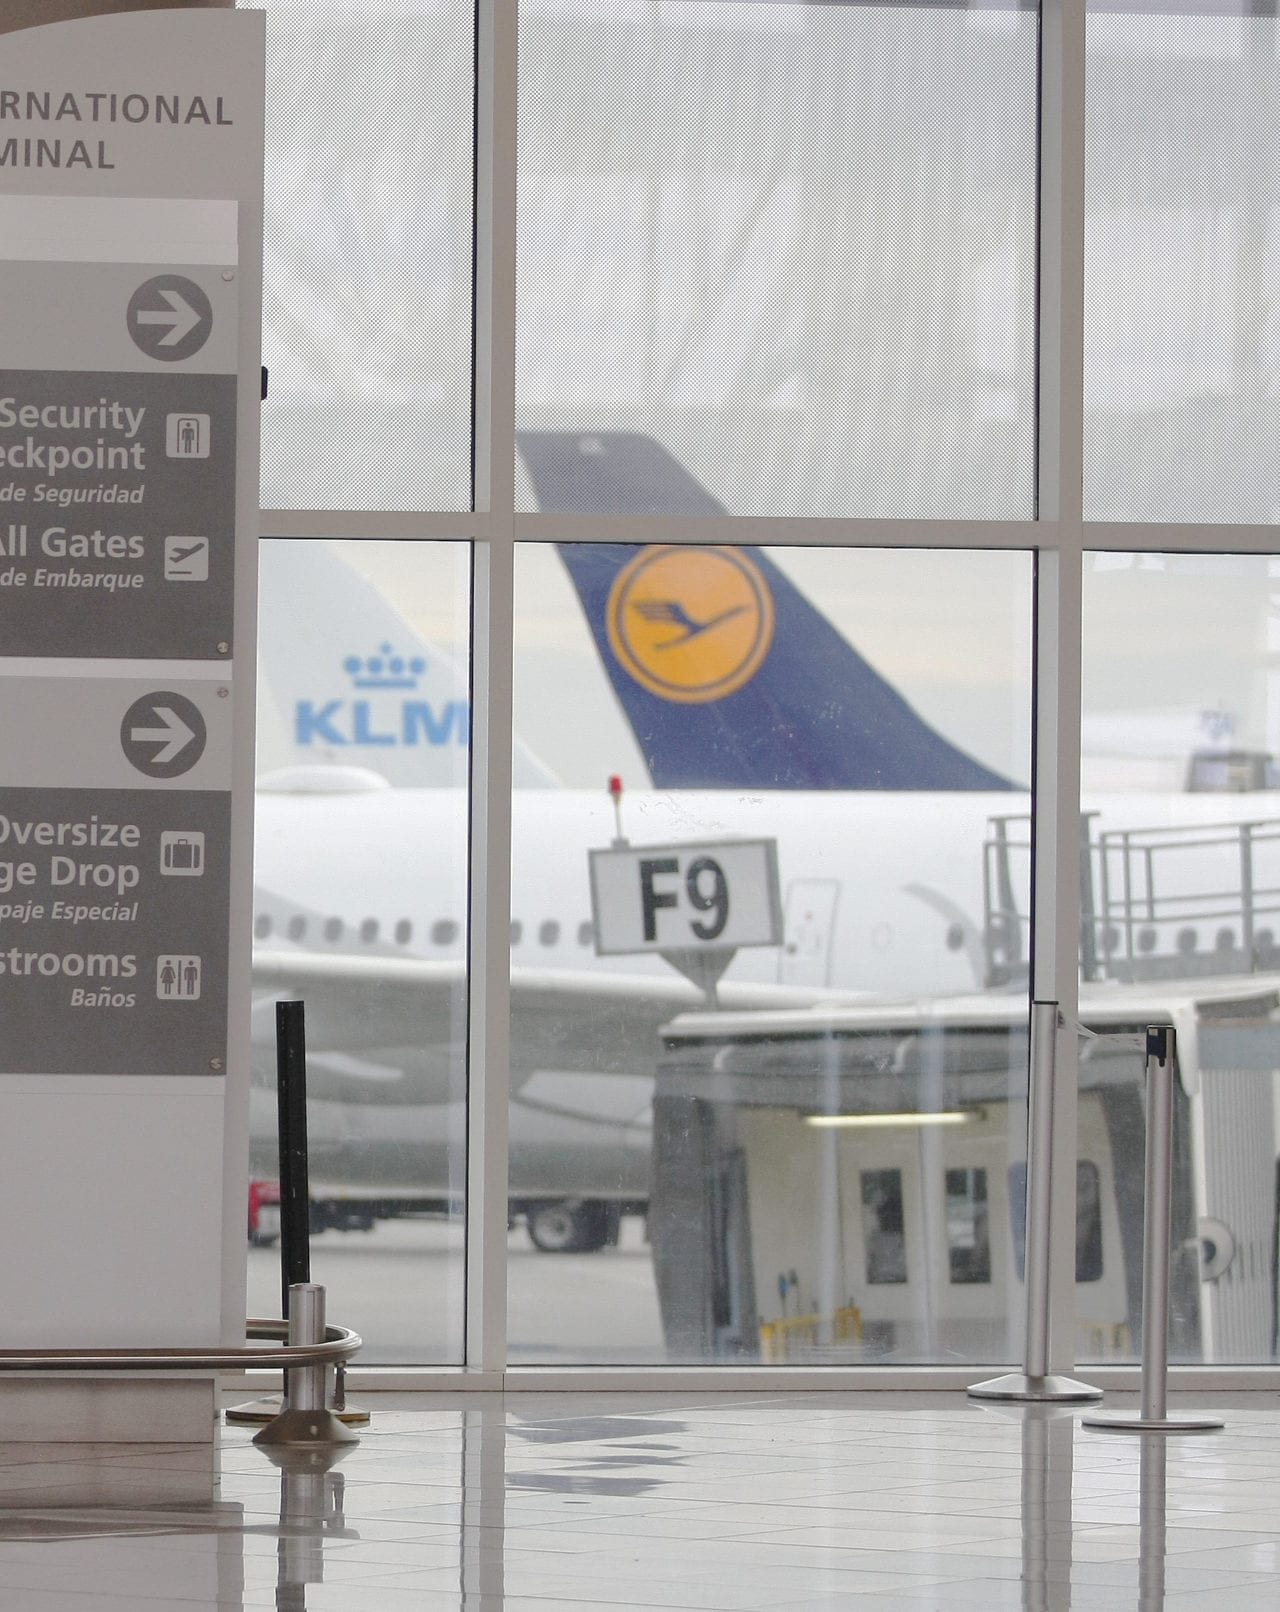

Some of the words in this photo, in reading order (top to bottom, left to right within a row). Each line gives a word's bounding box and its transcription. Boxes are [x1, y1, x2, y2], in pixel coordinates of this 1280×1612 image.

[32, 483, 146, 508] Seguridad
[40, 526, 145, 559] Gates
[0, 566, 27, 587] de
[33, 567, 145, 593] Embarque
[295, 700, 469, 746] KLM
[50, 855, 140, 896] Drop
[51, 901, 138, 925] Especial
[639, 856, 729, 941] F9
[70, 985, 136, 1008] Baños
